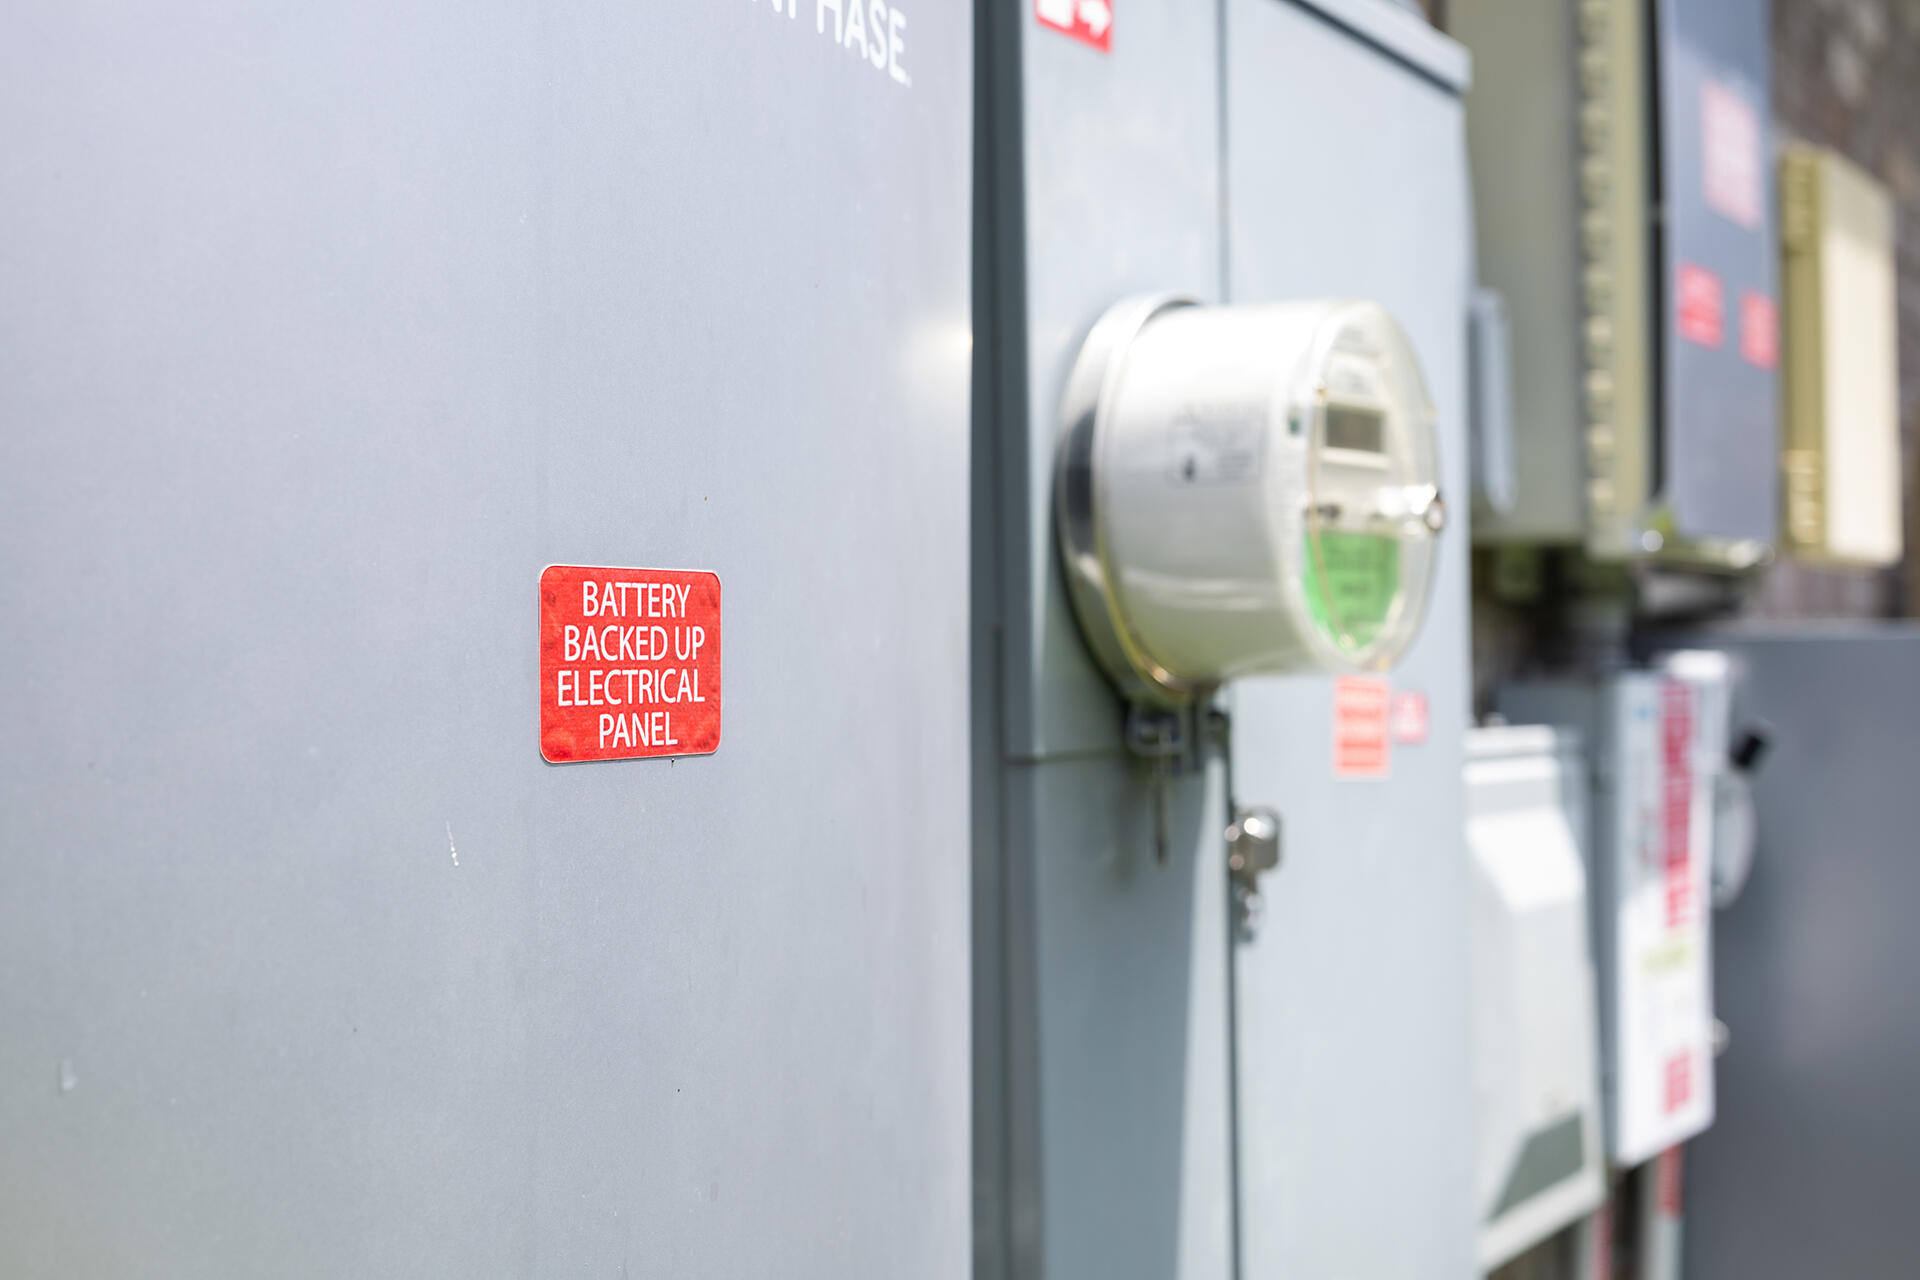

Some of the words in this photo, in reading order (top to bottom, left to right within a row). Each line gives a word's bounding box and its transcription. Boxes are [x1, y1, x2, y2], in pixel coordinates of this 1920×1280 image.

[753, 0, 910, 86] HASE
[582, 580, 691, 618] BATTERY
[564, 624, 669, 661] BACKED
[674, 625, 706, 661] UP
[557, 668, 706, 706] ELECTRICAL
[599, 711, 678, 749] PANEL
